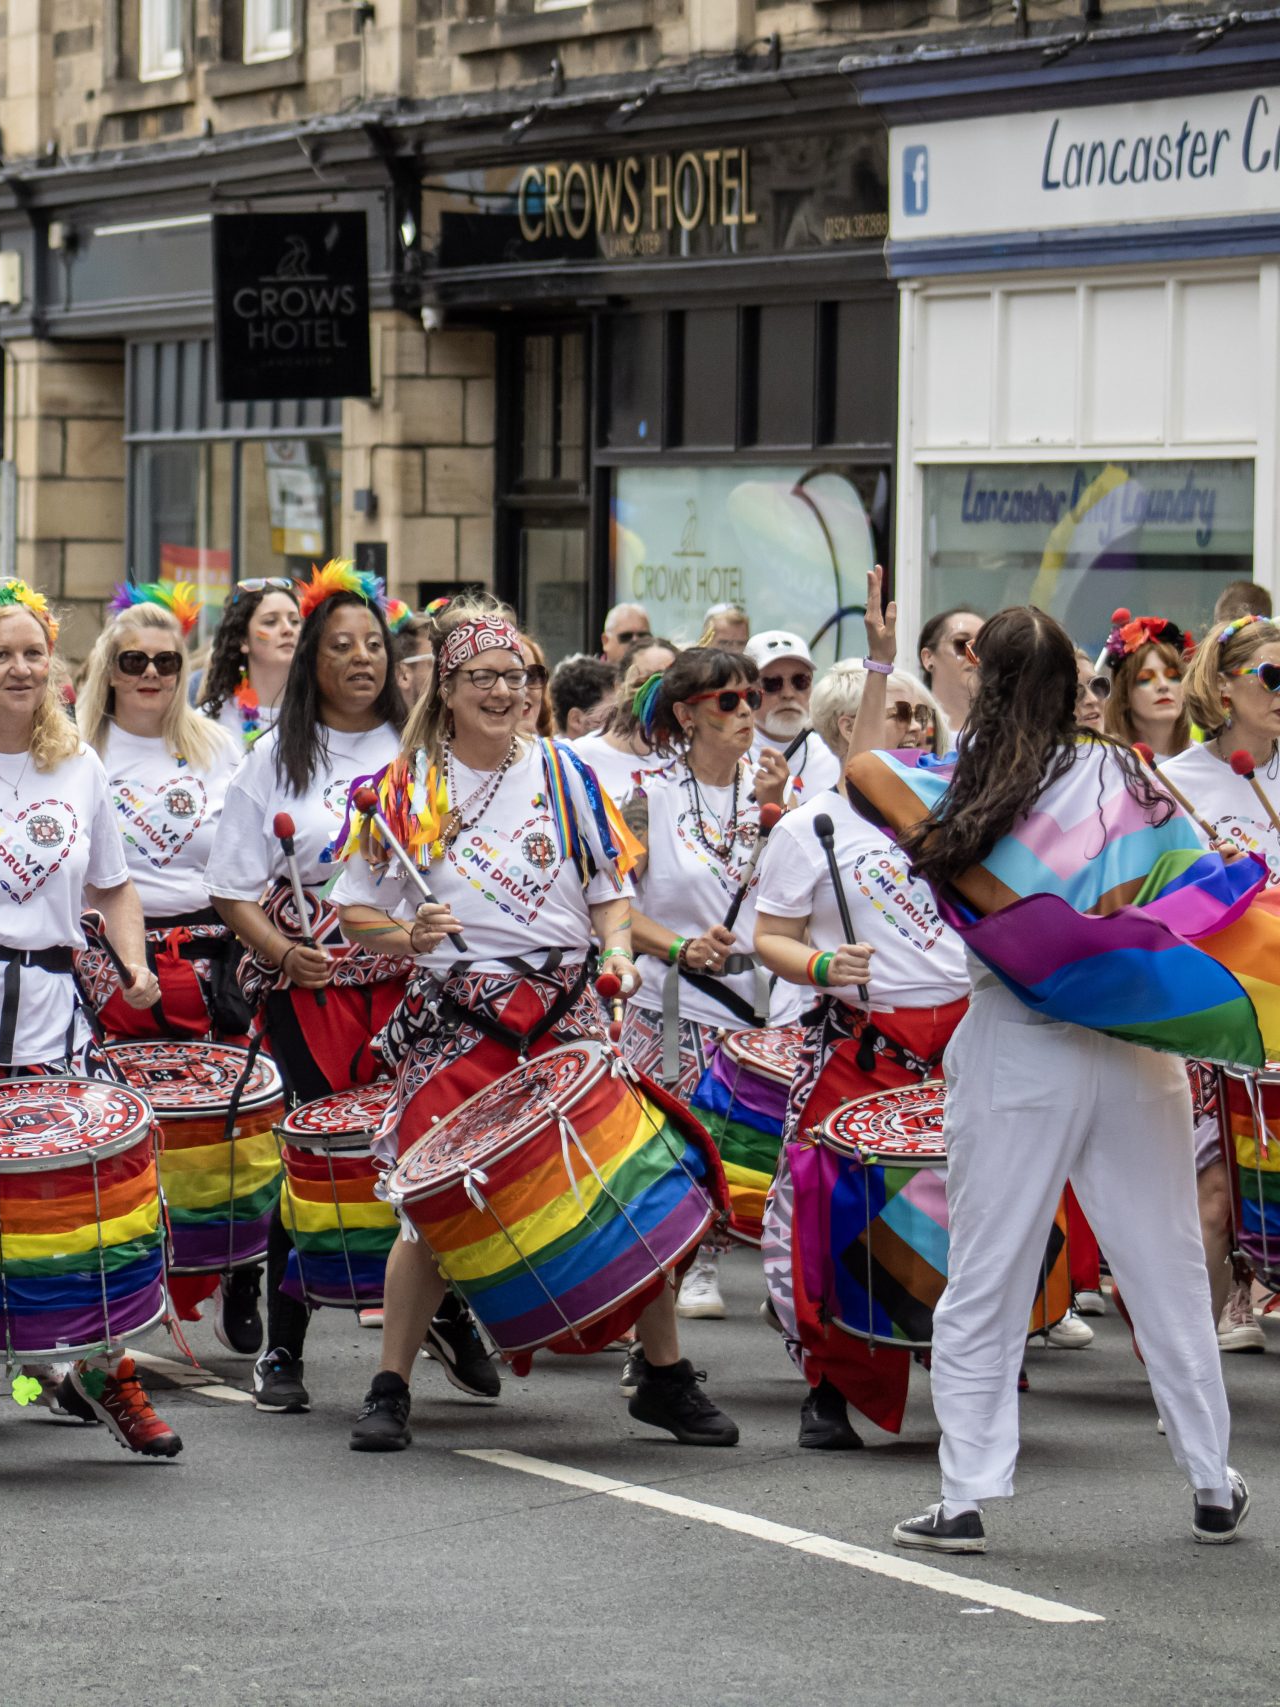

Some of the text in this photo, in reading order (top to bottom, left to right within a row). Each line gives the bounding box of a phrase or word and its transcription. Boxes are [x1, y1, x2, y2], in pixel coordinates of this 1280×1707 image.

[1042, 118, 1230, 190] Lancaster
[519, 148, 757, 241] CROWS HOTEL
[609, 234, 660, 257] LANCASTER
[824, 216, 851, 240] 01524
[233, 286, 355, 318] CROWS
[248, 320, 347, 349] HOTEL
[961, 469, 1066, 523] Lancaster
[1122, 469, 1216, 547] Laundry
[632, 565, 691, 601] CROWS
[697, 565, 745, 602] HOTEL
[120, 787, 144, 809] ONE
[142, 806, 177, 844] LOVE
[134, 816, 168, 852] DRUM
[1231, 827, 1259, 849] ONE
[3, 834, 45, 877] LOVE
[471, 836, 500, 860] ONE
[500, 856, 542, 897] LOVE
[879, 860, 906, 884] ONE
[461, 847, 488, 873] ONE
[490, 868, 530, 907] DRUM
[868, 868, 929, 935] ONE DRUM
[113, 1045, 213, 1058] ATALA
[878, 1091, 946, 1107] BATA
